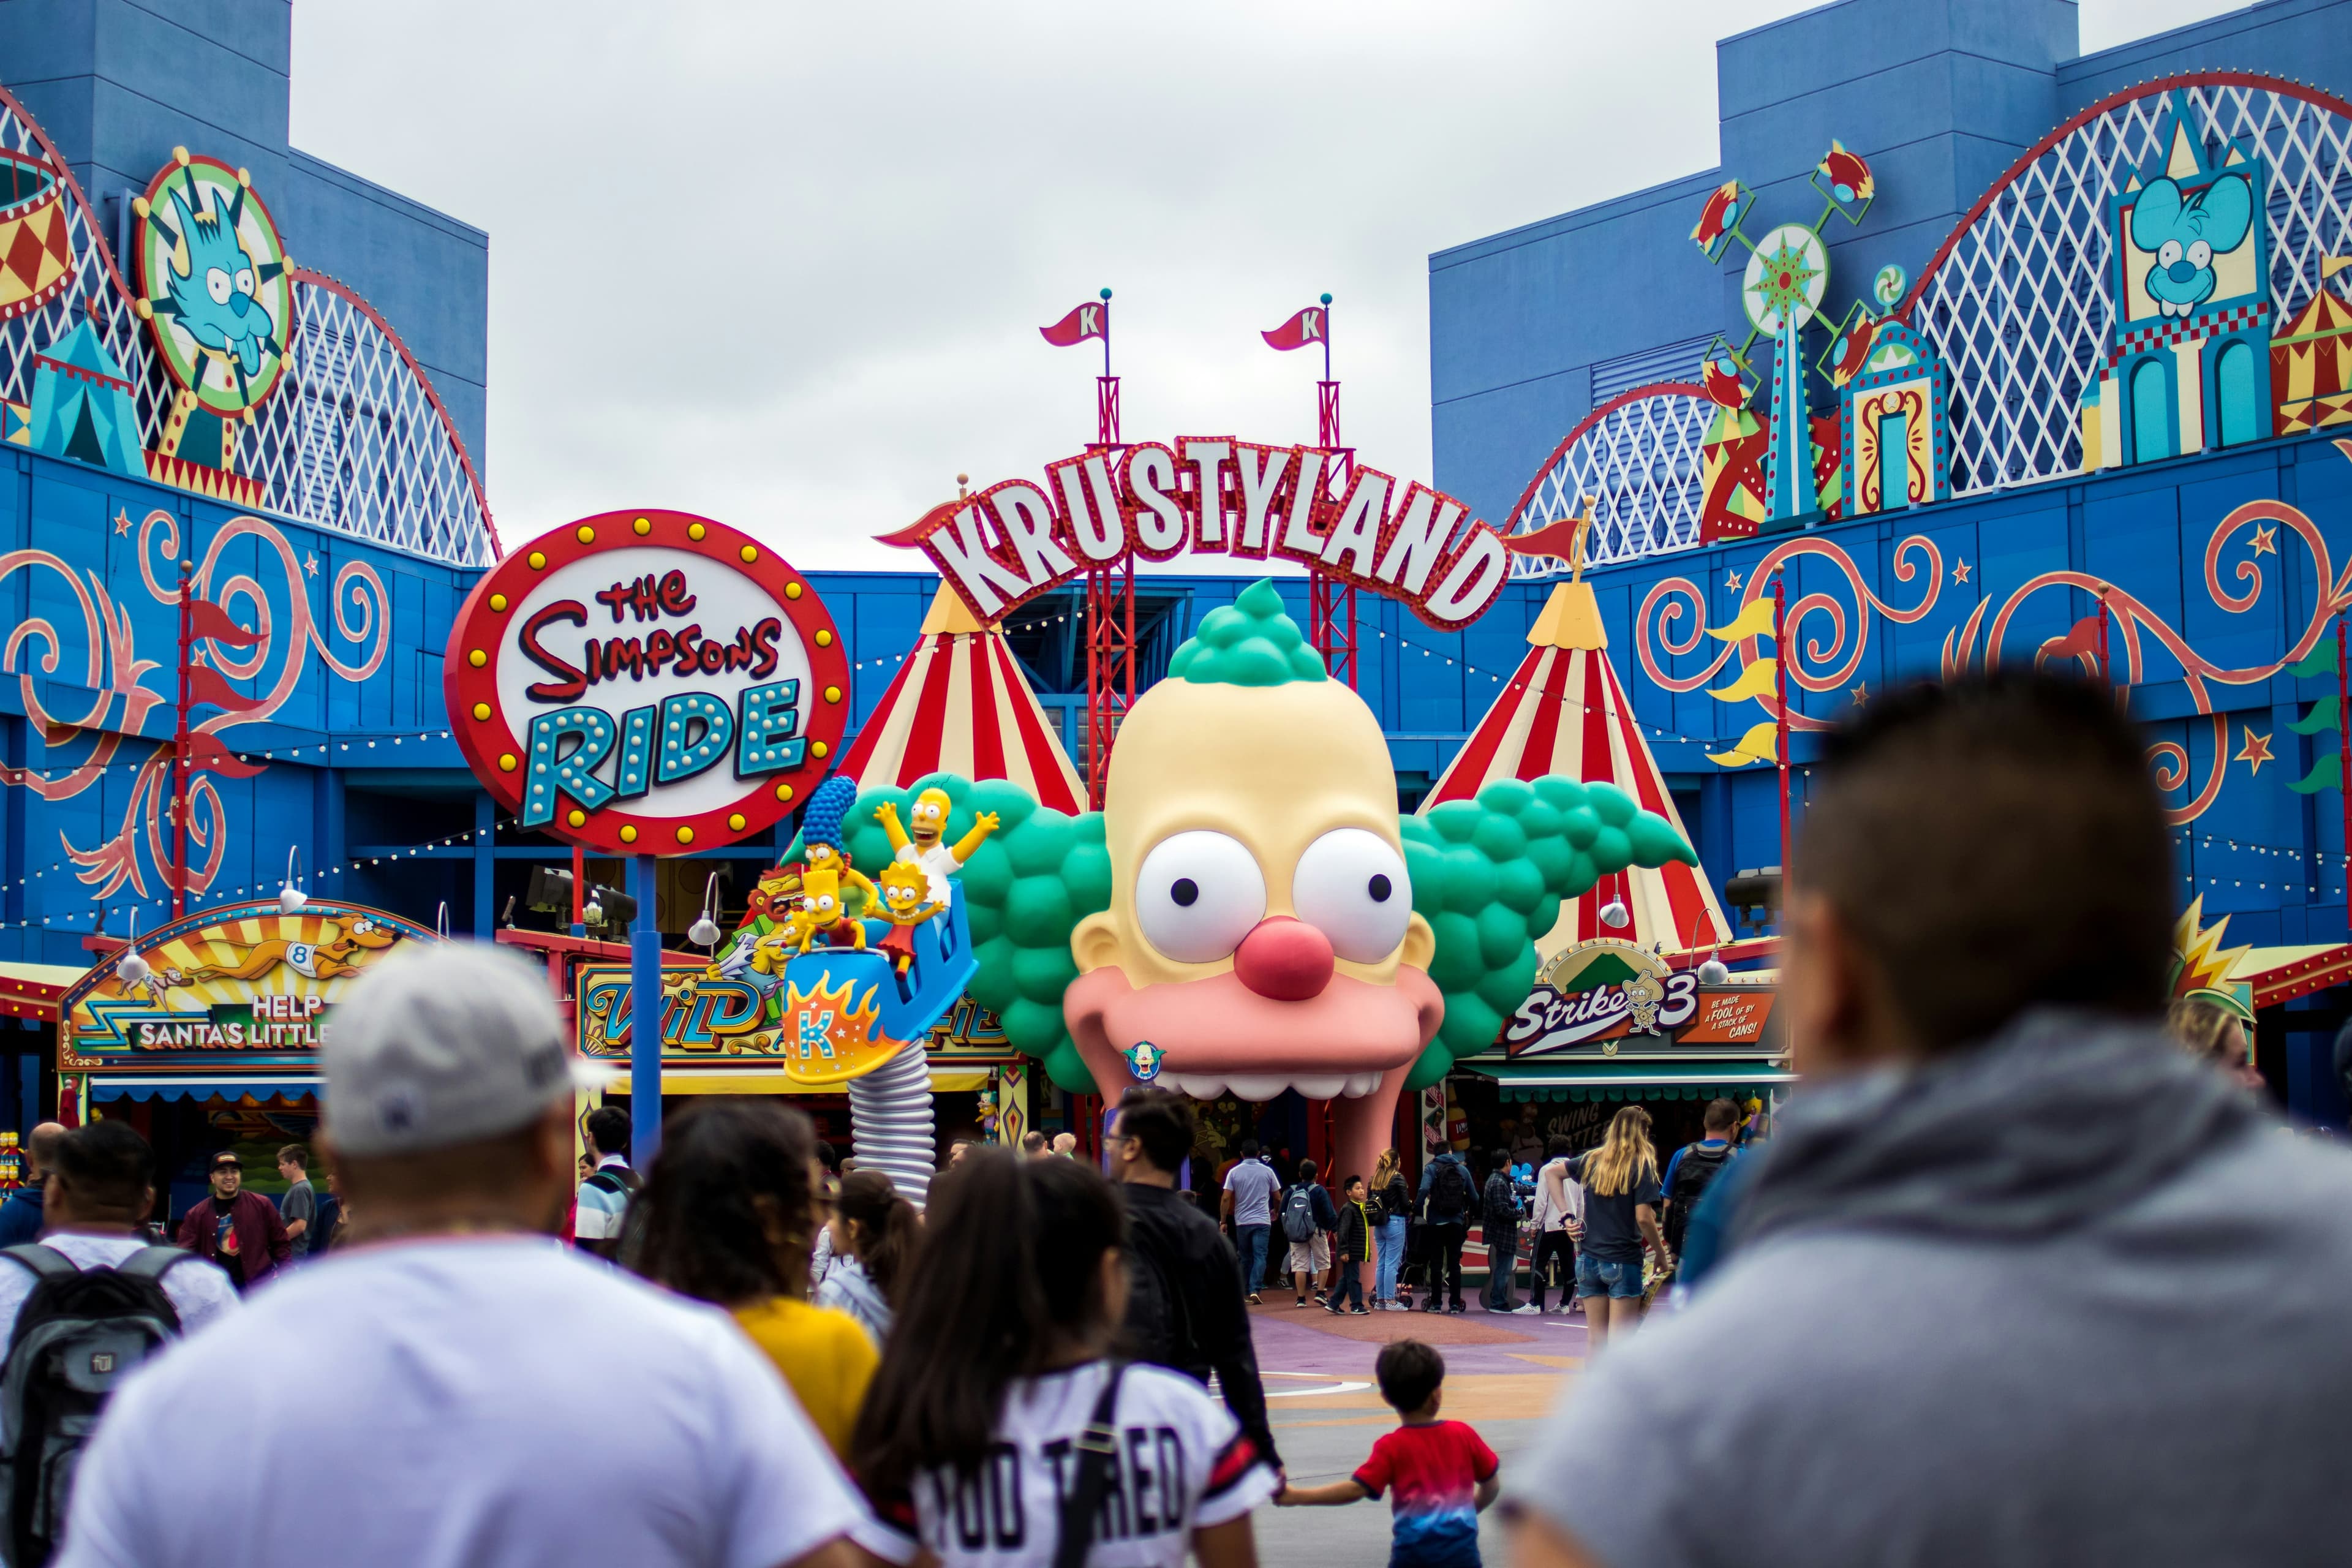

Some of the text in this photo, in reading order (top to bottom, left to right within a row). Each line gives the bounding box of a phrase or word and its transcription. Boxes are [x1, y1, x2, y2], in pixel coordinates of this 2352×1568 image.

[1080, 306, 1100, 337] K
[1302, 310, 1321, 341] K
[922, 437, 1511, 628] KRUSTYLAND
[518, 677, 808, 832] RIDE
[292, 946, 307, 964] 8
[252, 994, 322, 1020] HELP
[1506, 974, 1697, 1041] Strike 3
[1711, 995, 1740, 1009] BE MADE
[1711, 1006, 1733, 1021] FOOL
[1735, 1006, 1745, 1015] OF
[1745, 1004, 1755, 1013] BY
[139, 1023, 245, 1047] SANTA'S
[799, 1010, 836, 1059] K
[1717, 1017, 1738, 1030] STACK
[1738, 1015, 1747, 1024] OF
[1728, 1021, 1758, 1039] CANS!
[1545, 1102, 1600, 1137] SWING
[1042, 1428, 1185, 1539] TRED
